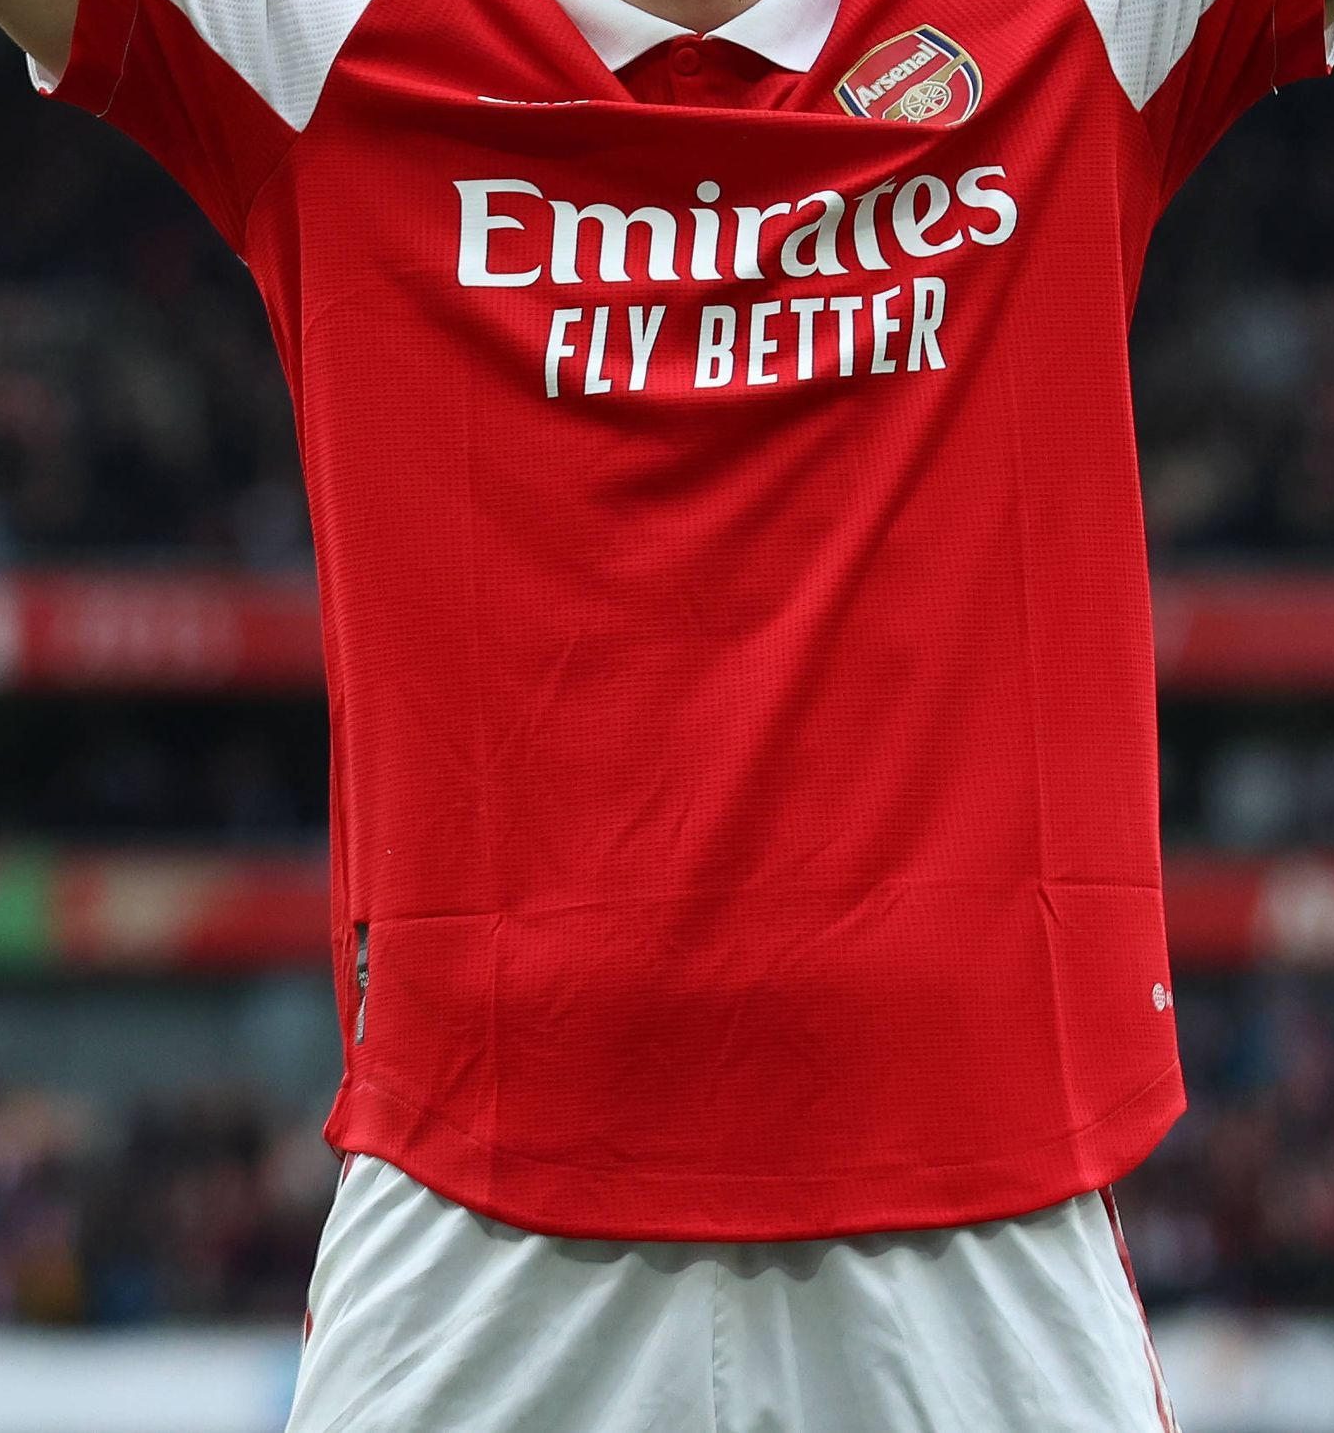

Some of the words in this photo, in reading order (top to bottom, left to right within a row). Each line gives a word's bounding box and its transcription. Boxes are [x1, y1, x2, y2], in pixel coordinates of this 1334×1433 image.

[855, 42, 939, 109] Arsenal
[453, 165, 1018, 287] Emirates
[545, 305, 668, 398] FLY
[694, 277, 947, 389] BETTER
